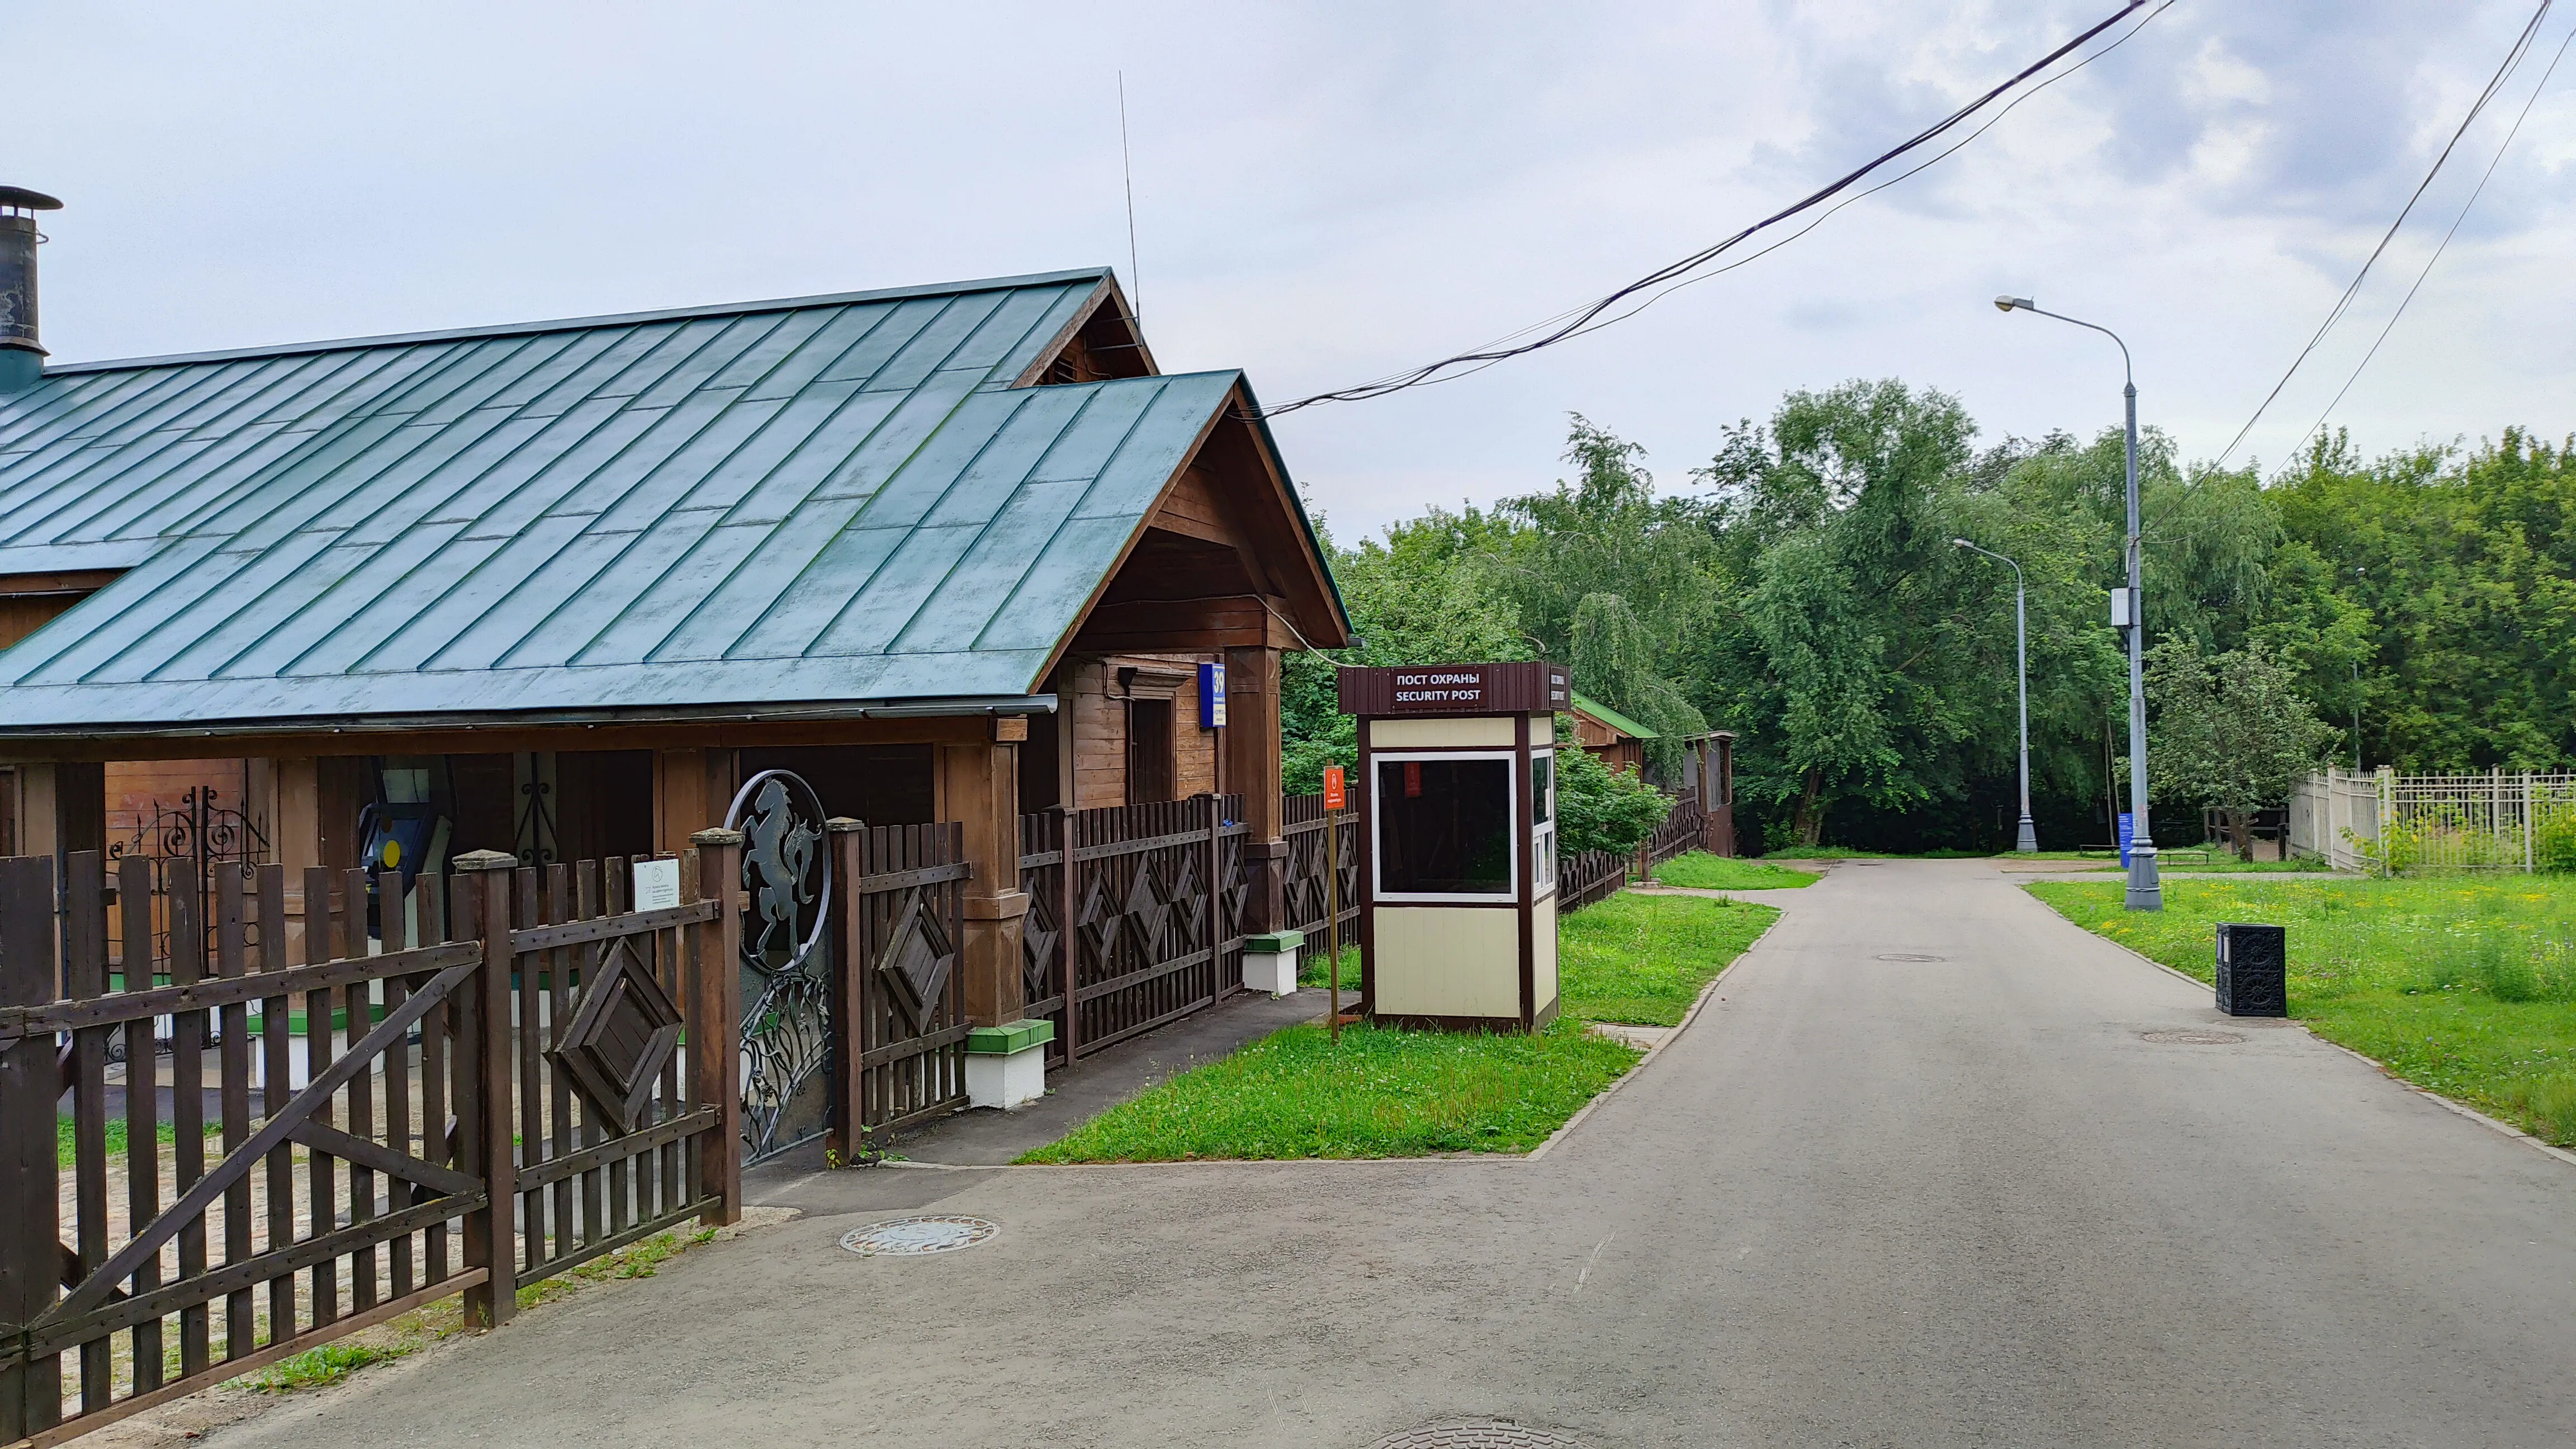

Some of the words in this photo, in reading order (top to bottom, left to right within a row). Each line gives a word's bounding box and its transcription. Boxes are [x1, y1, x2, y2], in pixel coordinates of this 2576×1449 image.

[1214, 671, 1224, 693] 39
[1396, 675, 1428, 685] ПОСТ
[1430, 673, 1480, 685] ОХРАНЫ
[1396, 690, 1449, 702] SECURITY
[1452, 690, 1481, 700] POST
